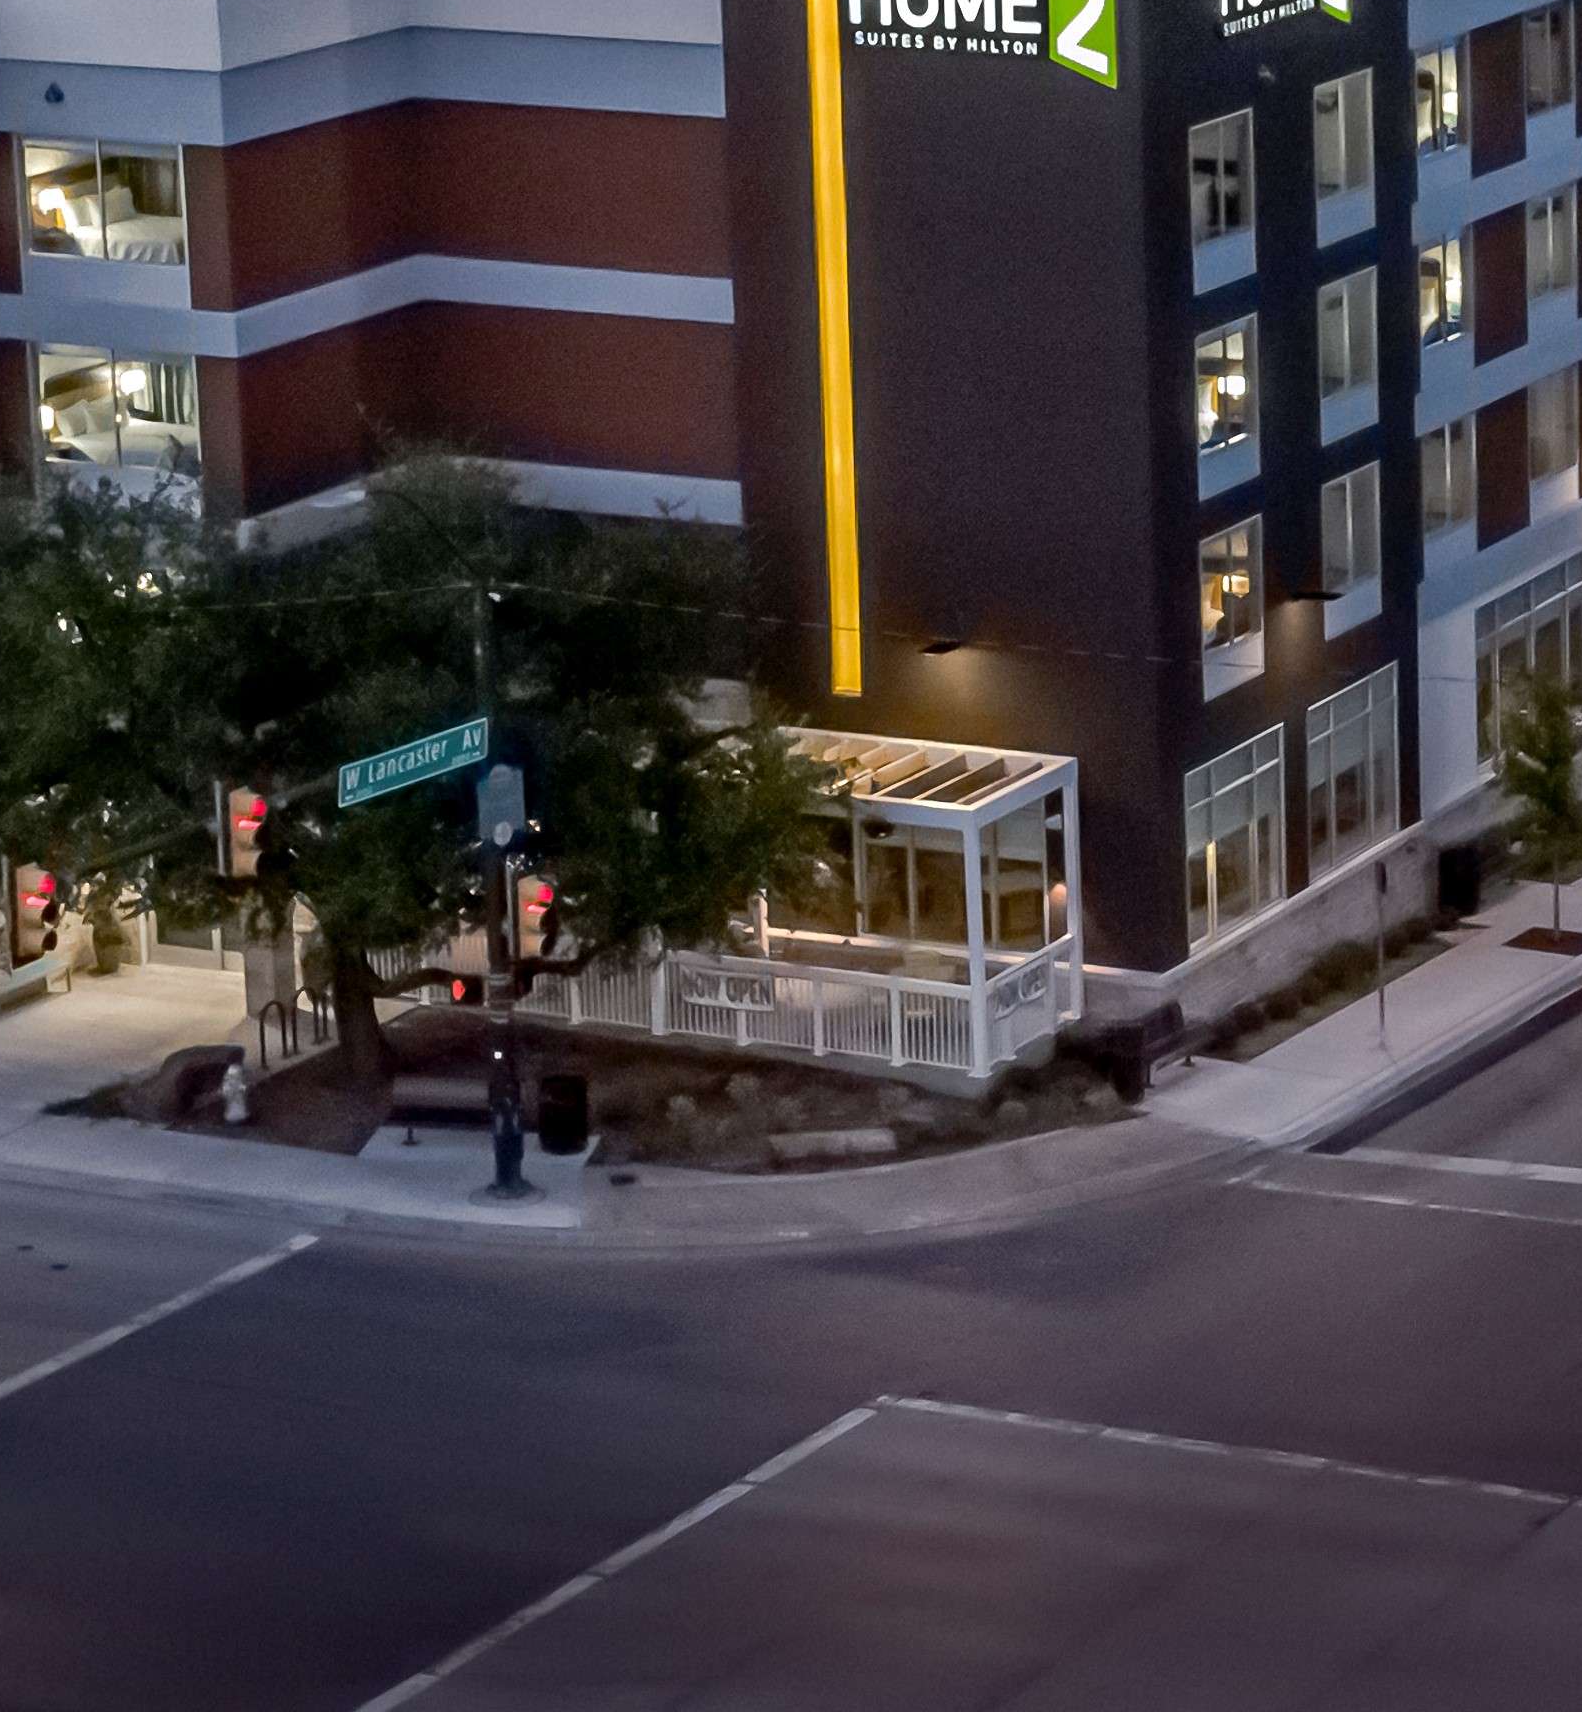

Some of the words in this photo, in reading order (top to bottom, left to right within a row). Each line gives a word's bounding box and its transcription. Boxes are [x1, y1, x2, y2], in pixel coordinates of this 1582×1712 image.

[1223, 12, 1260, 37] SUITES
[1262, 7, 1276, 24] BY
[854, 30, 925, 49] SUITES
[933, 35, 958, 51] BY
[966, 37, 1039, 56] HILTON
[345, 766, 361, 790] W
[368, 738, 448, 784] Lancaster
[462, 726, 482, 750] Av
[726, 976, 771, 1006] OPEN
